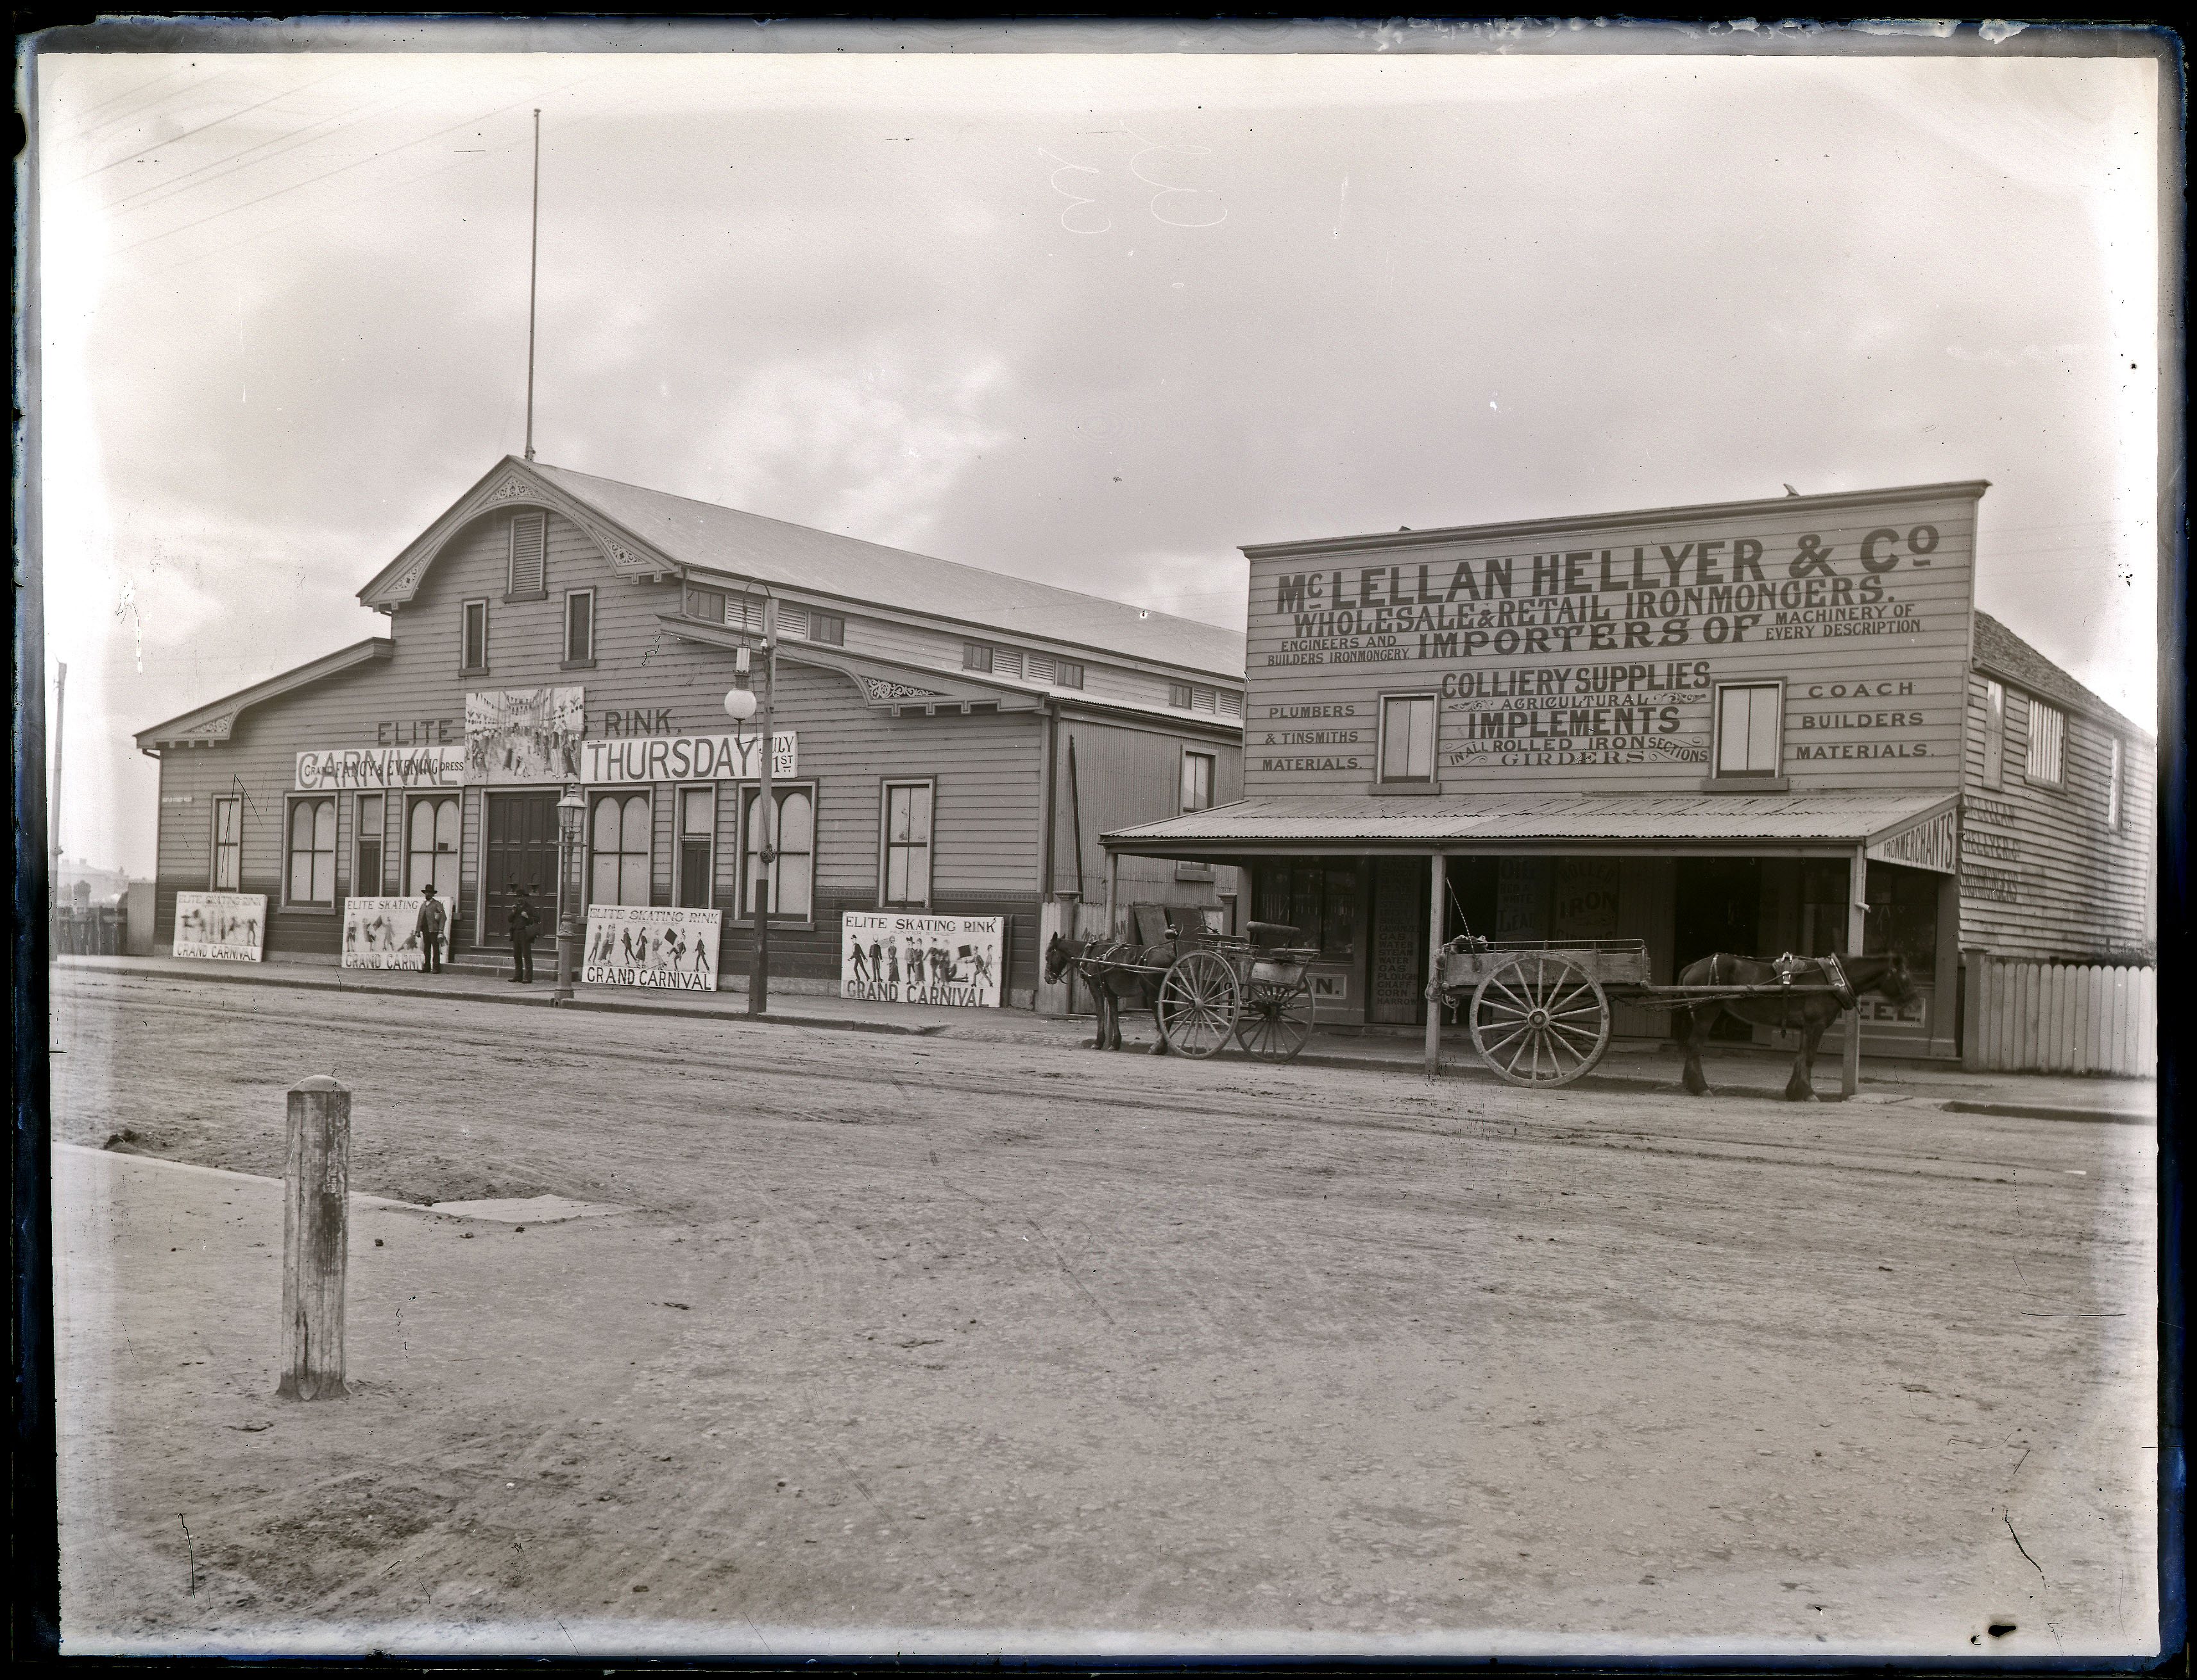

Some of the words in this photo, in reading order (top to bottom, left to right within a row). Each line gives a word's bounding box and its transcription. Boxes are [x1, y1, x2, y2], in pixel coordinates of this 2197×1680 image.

[1532, 539, 1765, 597] HELLYER
[1789, 534, 1838, 578] &
[1294, 603, 1475, 638] WHOLESALE
[1497, 595, 1610, 629] RETAIL
[1625, 575, 1894, 619] IRONMONGERS.
[1776, 606, 1887, 625] MACHINERY
[1893, 604, 1915, 617] OF
[1418, 618, 1690, 659] IMPORTERS
[1703, 614, 1763, 643] OF
[1766, 625, 1815, 641] EVERY
[1823, 619, 1925, 637] DESCRIPTION.
[1282, 637, 1359, 652] ENGINEERS
[1366, 635, 1396, 648] AND
[1268, 653, 1323, 666] BUILDERS
[1329, 649, 1410, 663] IRONMONGERY.
[1442, 668, 1572, 699] COLLIERY
[1575, 661, 1711, 694] SUPPLIES
[1808, 681, 1913, 699] COACH
[1500, 693, 1649, 710] AGRICULTURAL
[1269, 705, 1355, 718] PLUMBERS
[1802, 712, 1924, 729] BUILDERS
[378, 720, 453, 746] ELITE
[605, 708, 682, 736] RINK.
[1468, 706, 1681, 739] IMPLEMENTS
[759, 736, 794, 754] LY
[1265, 733, 1276, 744] &
[1281, 731, 1358, 745] TINSMITHS
[1493, 738, 1572, 752] ROLLED
[1589, 736, 1644, 751] IRON
[588, 736, 757, 781] THURSDAY
[1450, 751, 1463, 765] IN
[1463, 741, 1488, 757] ALL
[1648, 737, 1708, 762] SECTIONS
[1797, 743, 1934, 759] MATERIALS.
[299, 748, 457, 788] CARNIVAL
[1262, 758, 1362, 770] MATERIALS.
[1502, 751, 1644, 767] GIRDERS
[335, 761, 377, 778] FANCY
[387, 759, 438, 777] EVENING
[441, 761, 464, 772] DRESS
[347, 901, 374, 910] ELITE
[378, 900, 418, 910] SKATING
[590, 908, 625, 919] ELITE
[629, 910, 684, 922] SKATING
[689, 912, 718, 924] RINK
[845, 916, 888, 929] ELITE
[895, 919, 956, 932] SKATING
[964, 921, 995, 933] RINK
[177, 943, 207, 957] GRAND
[211, 946, 257, 961] CARNIVAL
[346, 953, 380, 969] GRAND
[387, 954, 423, 970] CARNI
[588, 967, 635, 985] GRAND
[640, 970, 711, 990] CARNIVAL
[847, 980, 898, 1002] GRAND
[906, 985, 989, 1007] CARNIVAL
